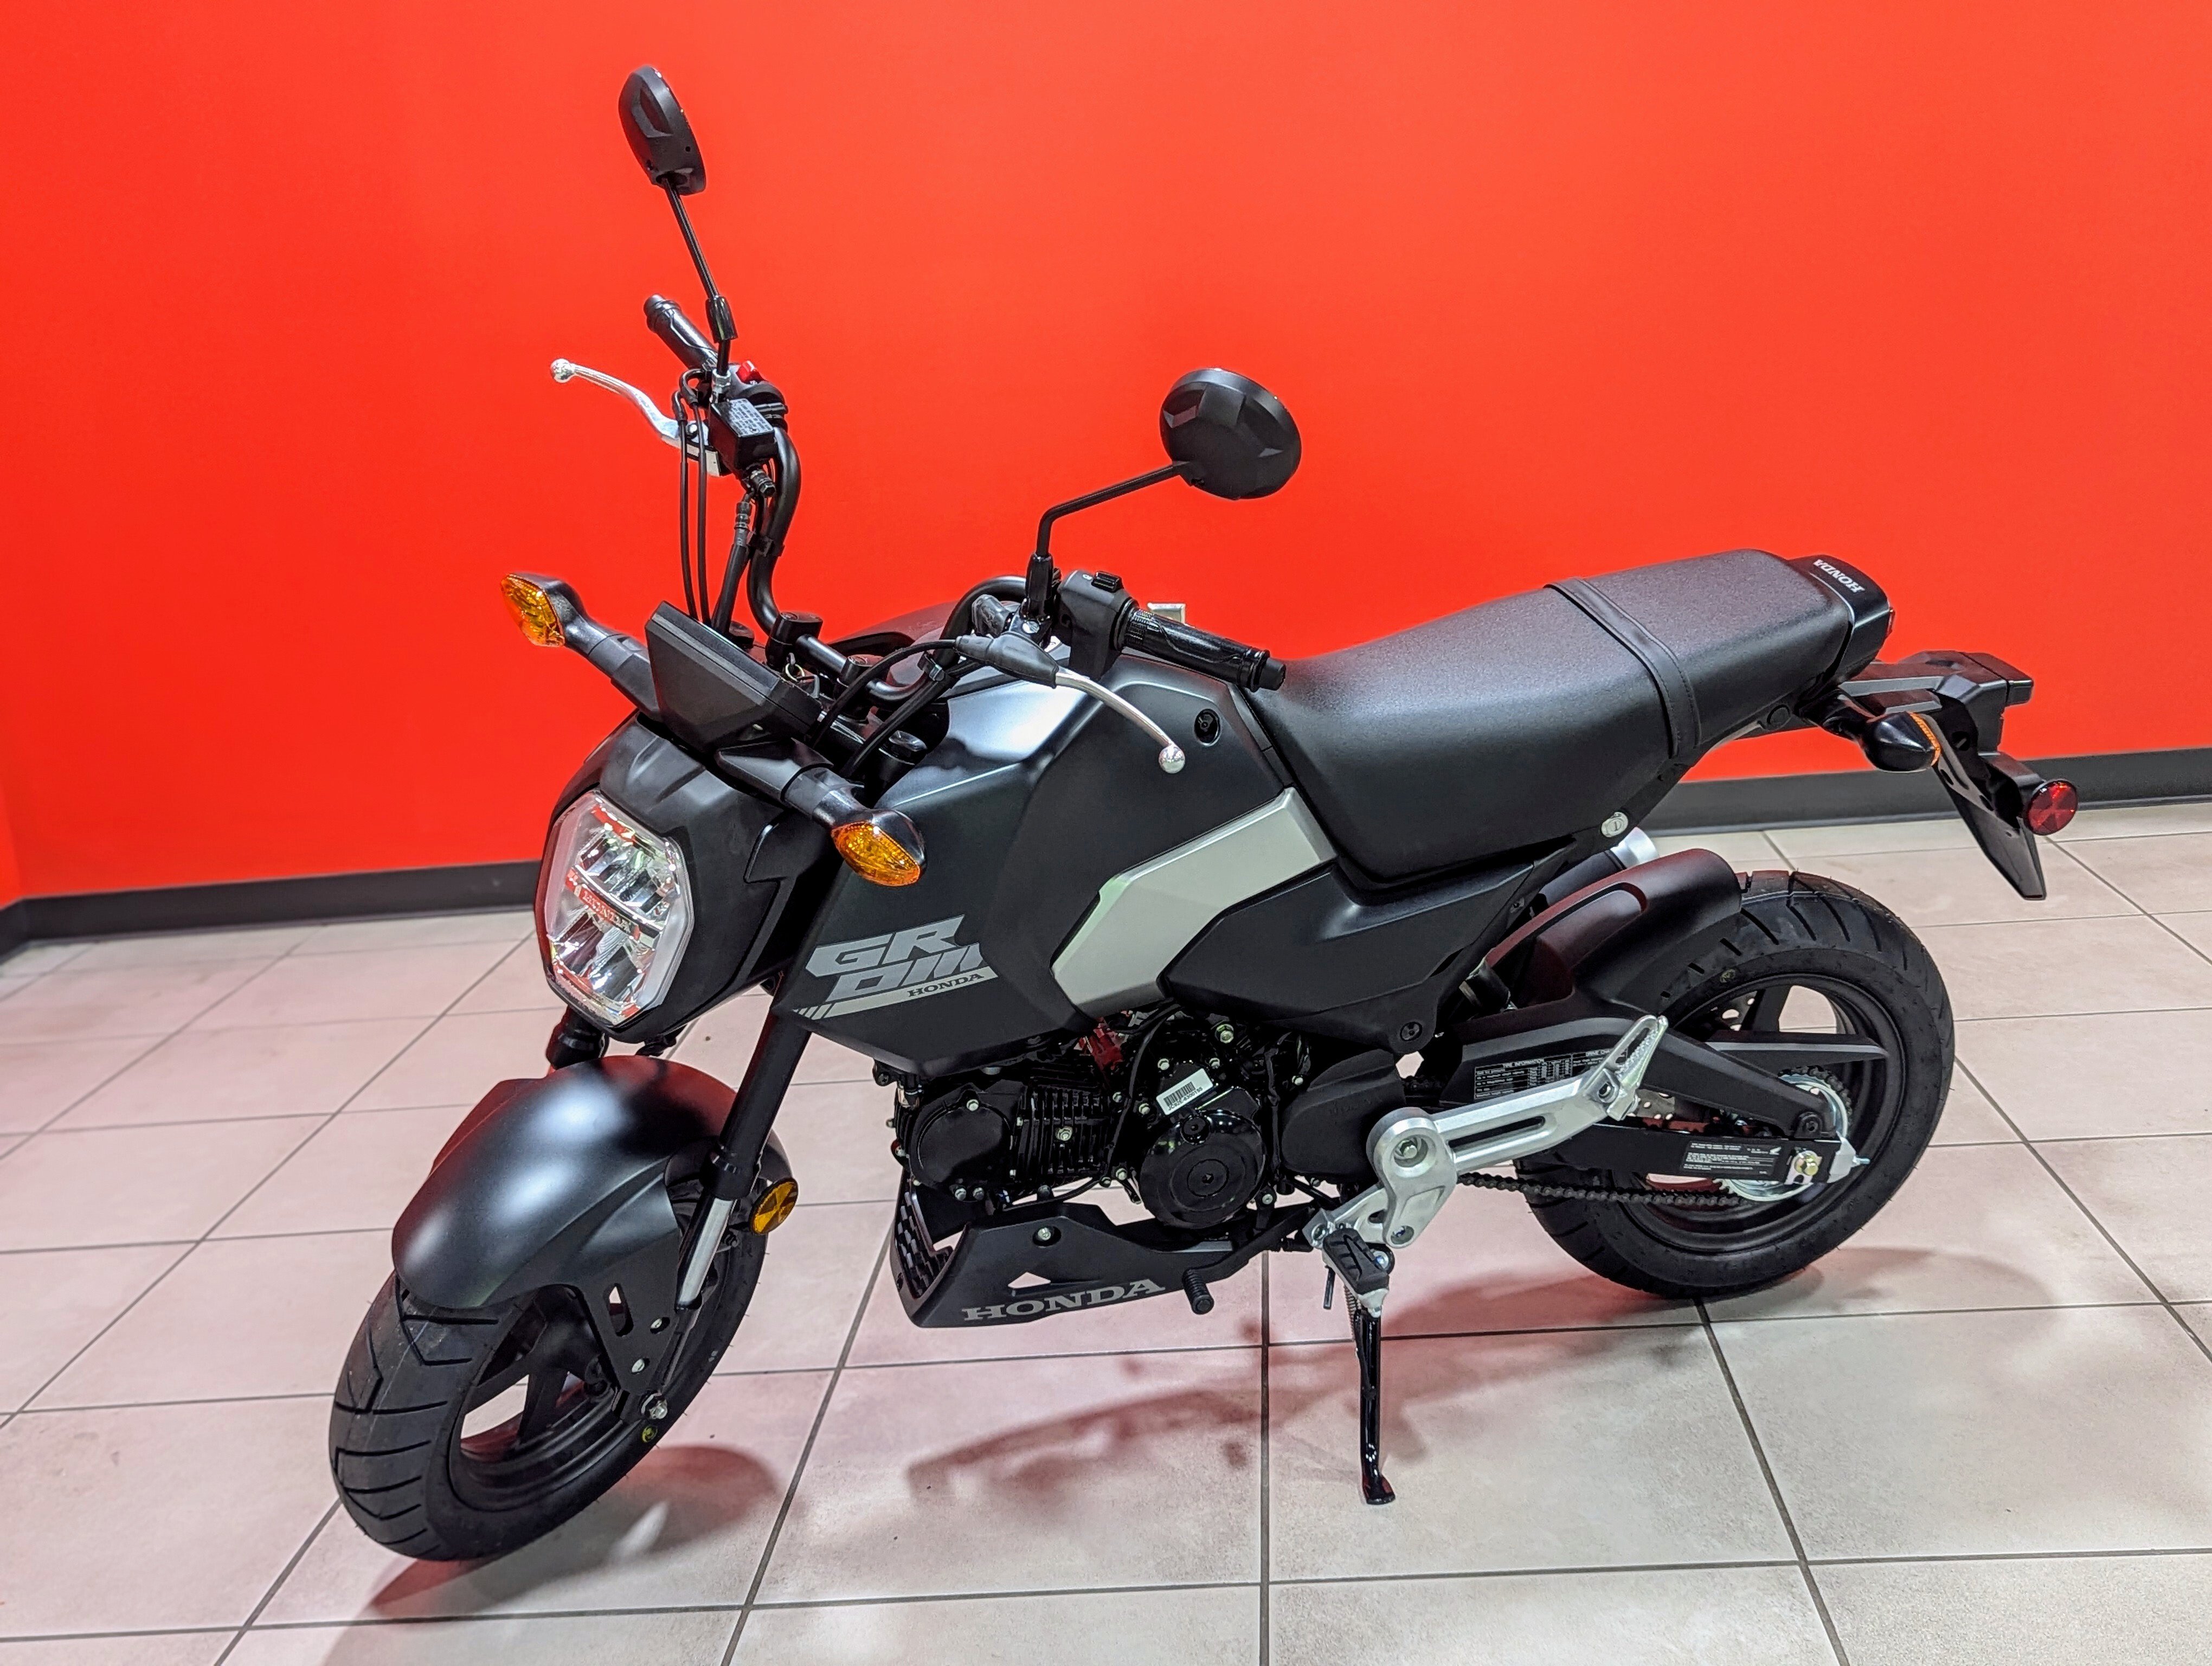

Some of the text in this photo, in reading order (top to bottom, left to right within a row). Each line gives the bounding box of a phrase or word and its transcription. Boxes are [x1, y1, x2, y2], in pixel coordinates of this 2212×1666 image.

[1813, 559, 1865, 593] HONDA
[582, 890, 631, 933] HONDA
[907, 973, 985, 997] HONDA
[962, 1279, 1165, 1321] HONDA
